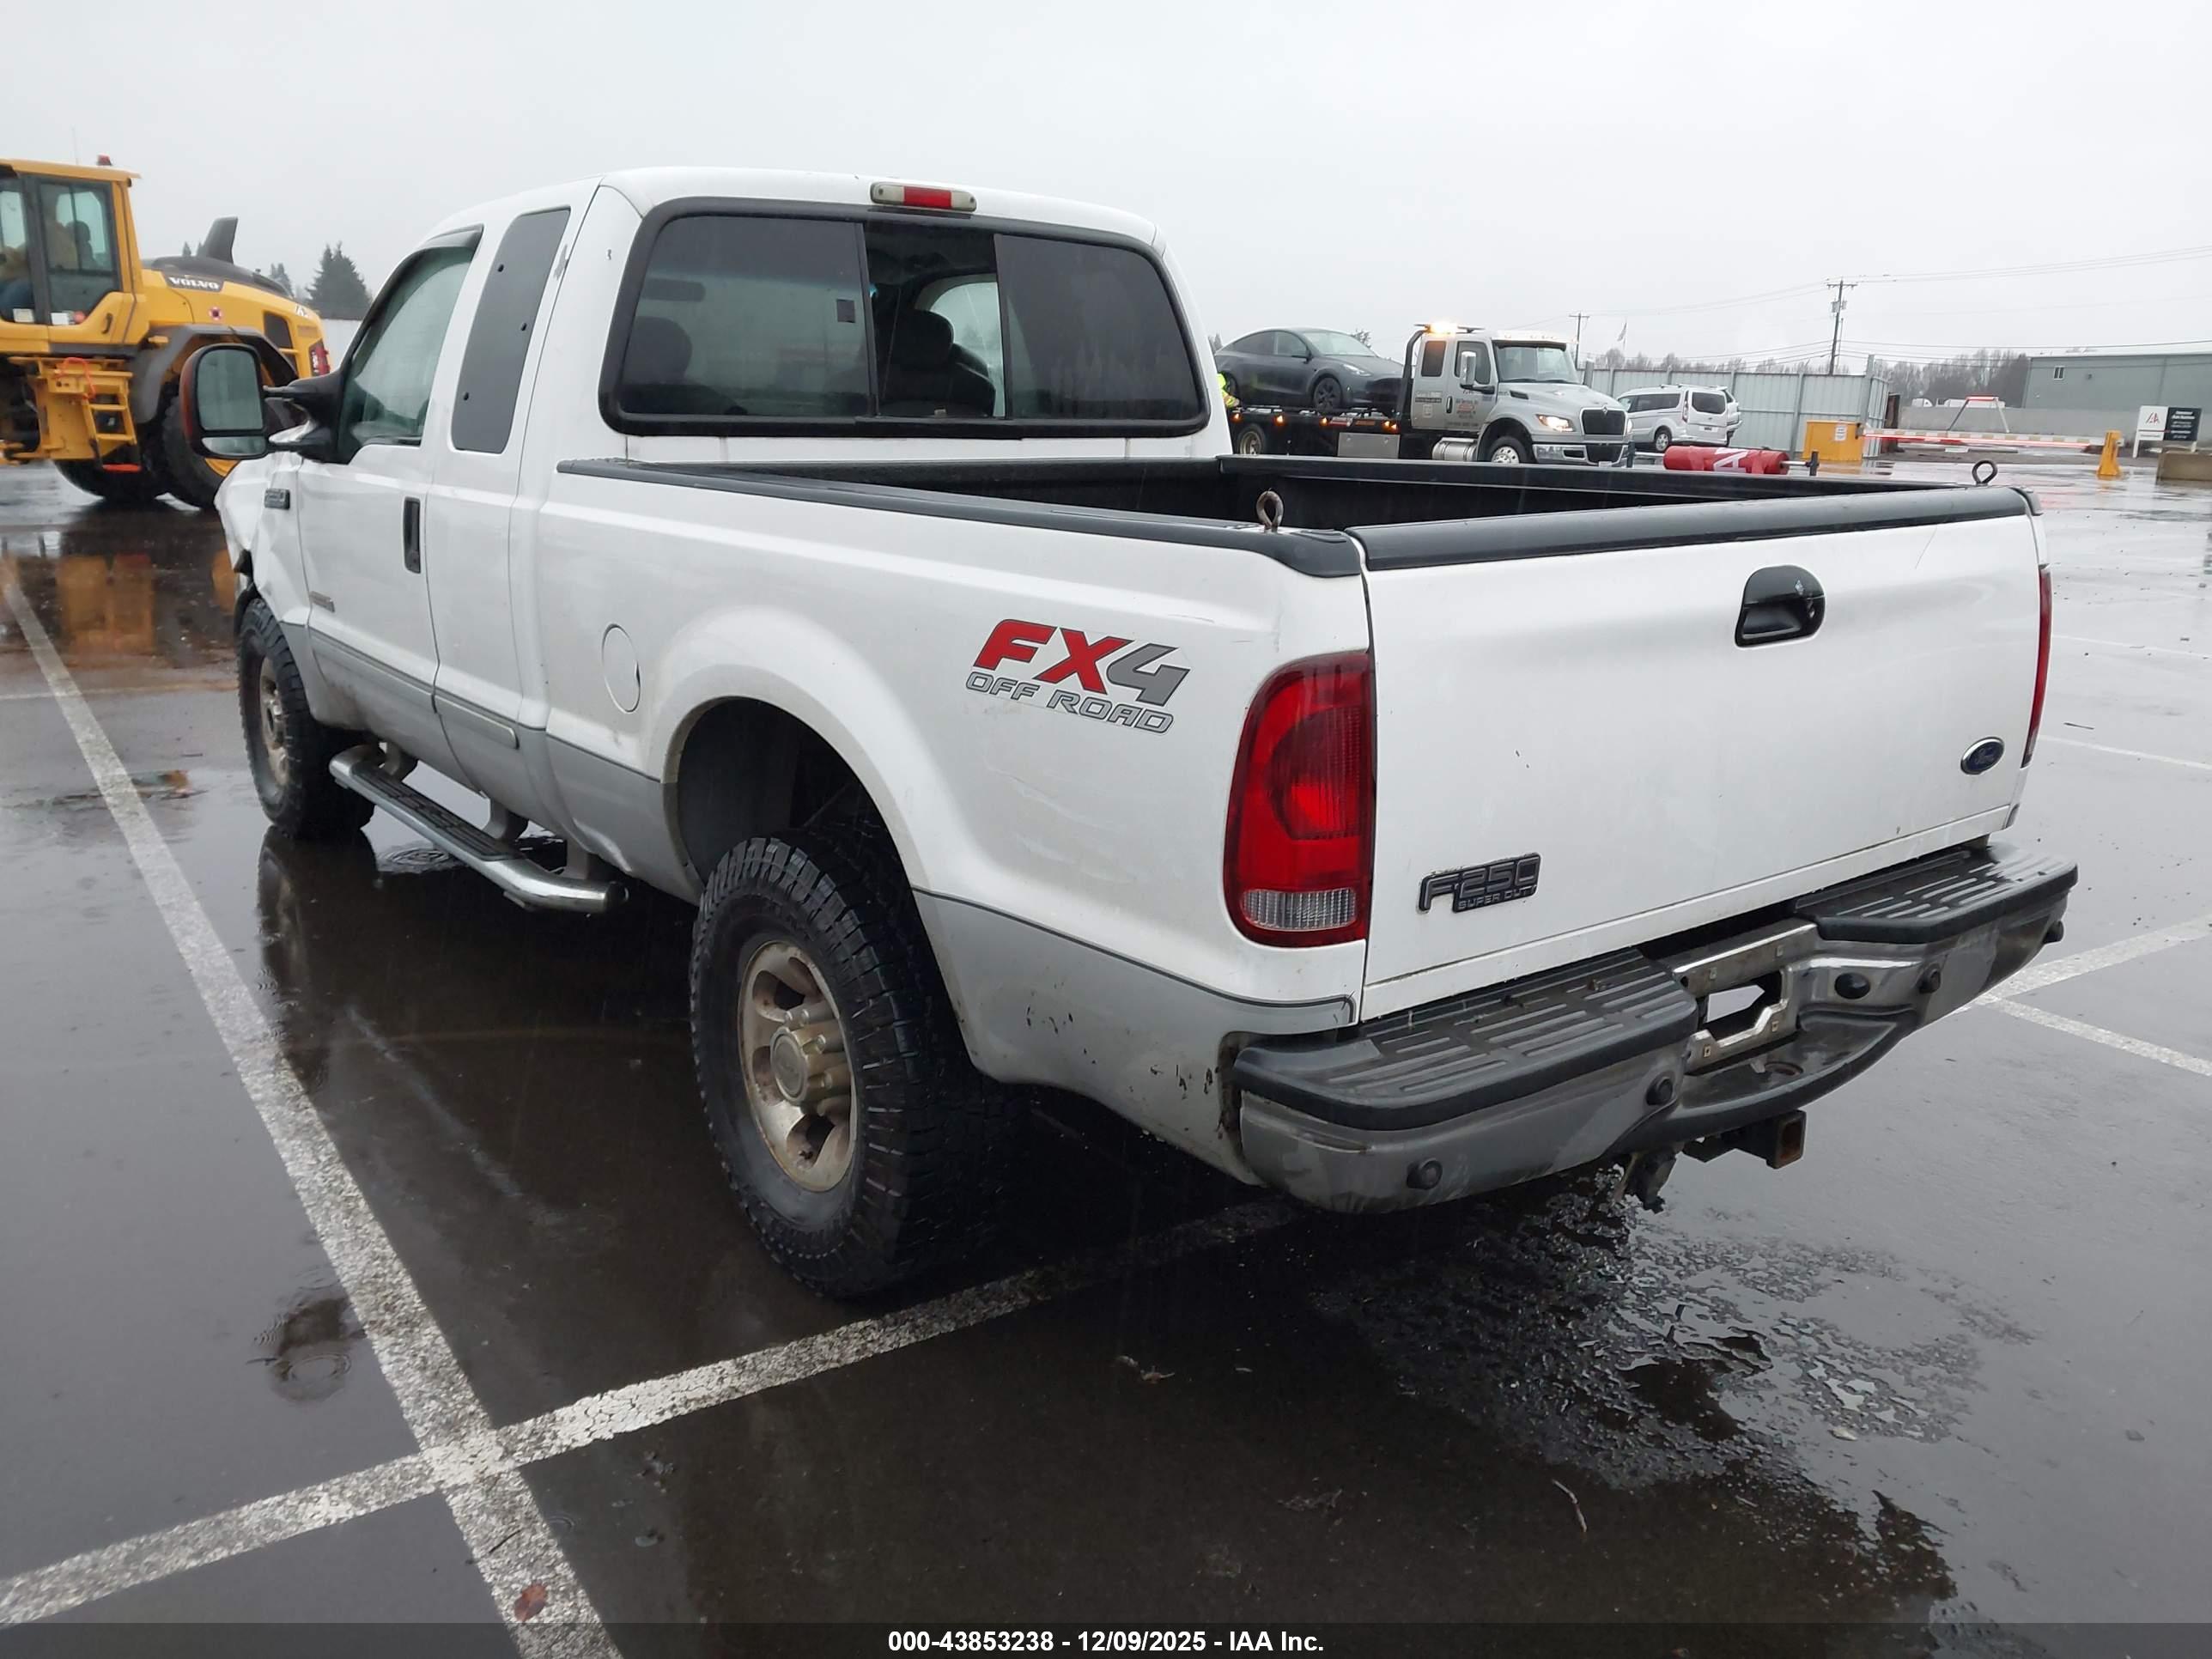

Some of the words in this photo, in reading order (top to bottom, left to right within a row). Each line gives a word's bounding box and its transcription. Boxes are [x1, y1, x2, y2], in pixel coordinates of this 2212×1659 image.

[167, 276, 221, 289] VOLVO
[972, 618, 1192, 708] FX4
[965, 671, 1040, 701] OFF
[1046, 689, 1175, 734] ROAD
[1457, 892, 1501, 910] SUPER
